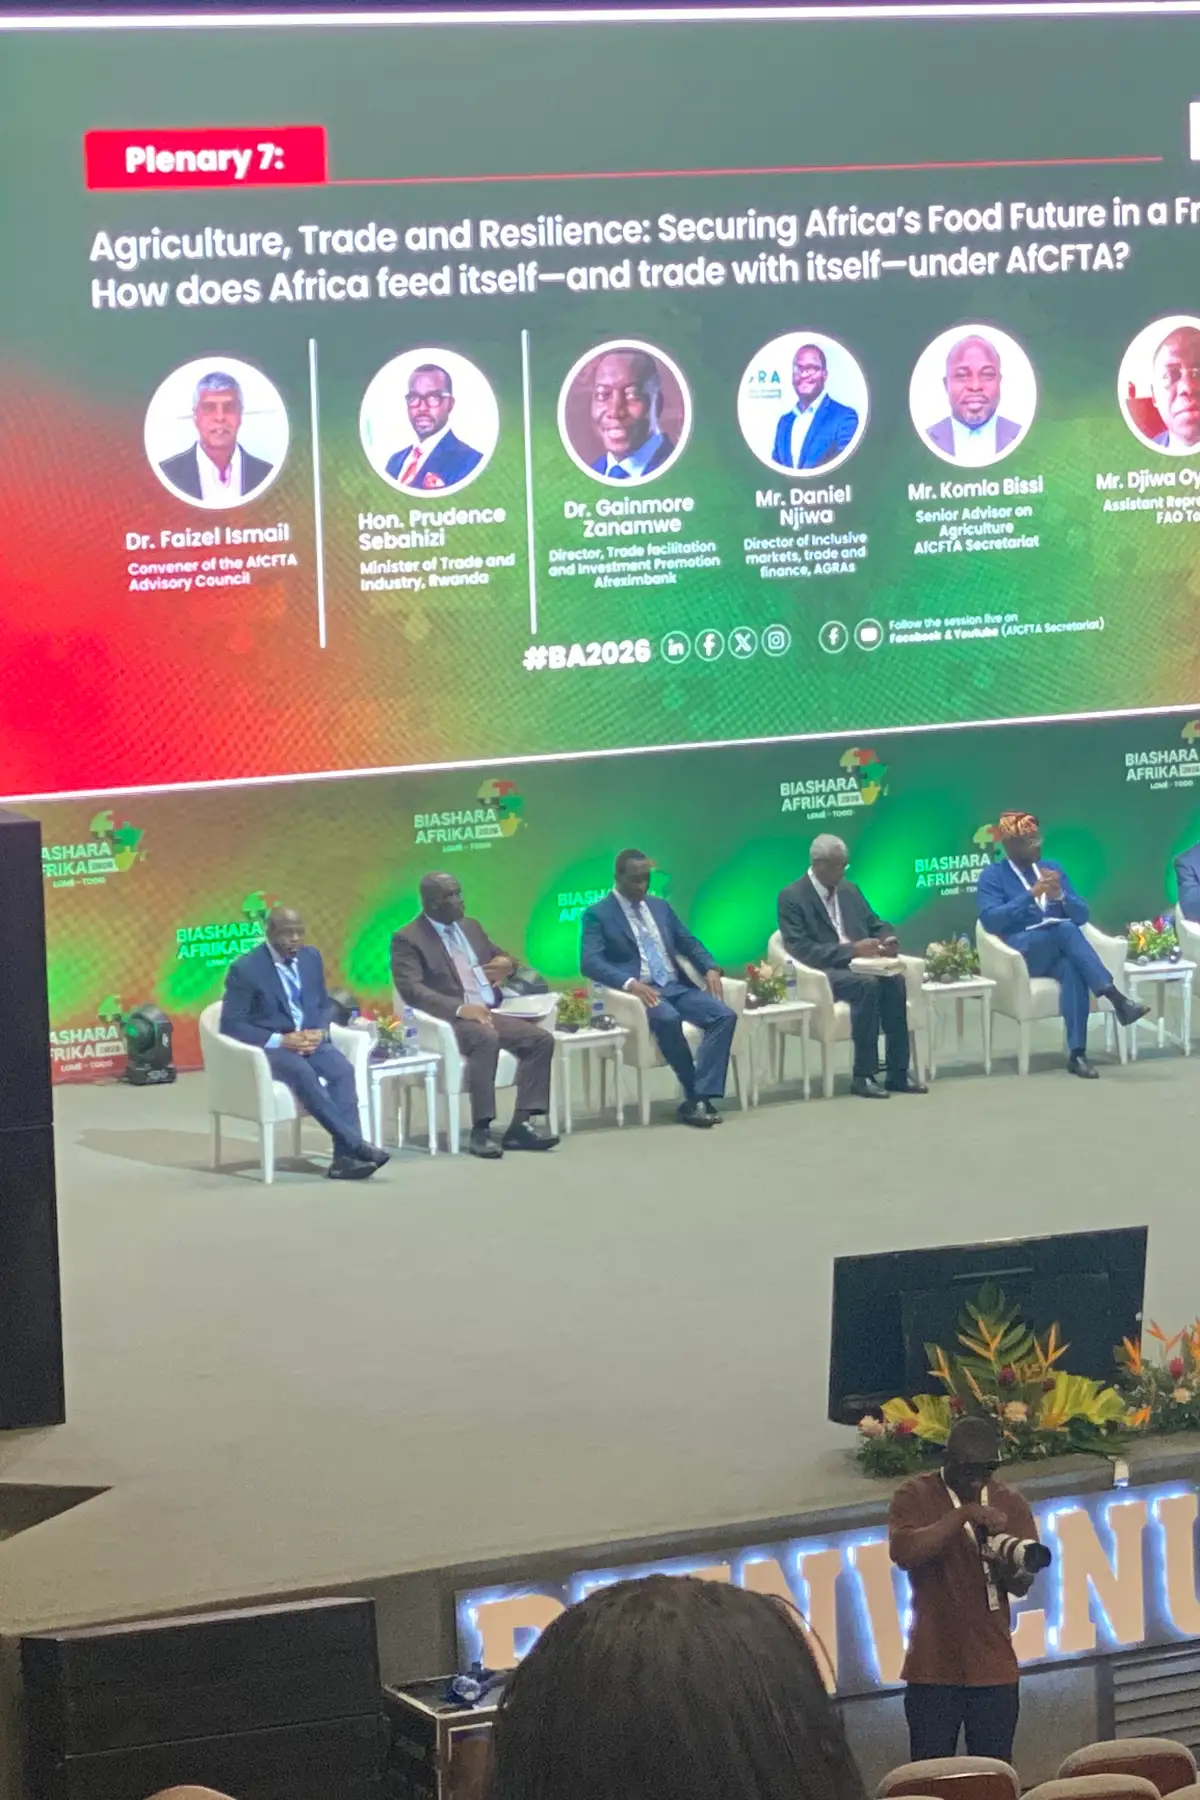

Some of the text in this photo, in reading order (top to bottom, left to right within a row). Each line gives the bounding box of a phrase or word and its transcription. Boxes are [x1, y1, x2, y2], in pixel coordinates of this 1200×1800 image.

[125, 144, 285, 180] Plenary 7:
[90, 225, 292, 268] Agriculture,
[300, 222, 398, 255] Trade
[405, 221, 472, 251] and
[480, 215, 651, 249] Resilience:
[658, 210, 798, 249] Securing
[929, 202, 1002, 234] Food
[1009, 199, 1107, 232] Future
[1112, 197, 1139, 226] in
[1147, 202, 1167, 226] a
[91, 277, 168, 309] How
[176, 274, 260, 306] does
[269, 268, 369, 303] Africa
[376, 266, 452, 298] feed
[638, 257, 725, 287] trade
[732, 253, 798, 283] with
[1007, 241, 1130, 273] AfCFTA?
[908, 475, 1043, 501] Mr. Komla Bissi
[1096, 474, 1123, 490] Mr.
[1127, 468, 1176, 493] Djiwa
[755, 485, 852, 507] Mr. Daniel
[1103, 498, 1164, 512] Assistant
[564, 496, 694, 518] Dr. Gainmore
[916, 506, 1033, 523] Senior Advisor on
[359, 506, 506, 530] Hon. Prudence
[583, 517, 682, 538] Zanamwe
[780, 507, 833, 530] Njiwa
[1156, 512, 1184, 525] FAO
[126, 523, 290, 550] Dr. Faizel Ismail
[359, 528, 445, 551] Sebahizi
[939, 522, 1014, 538] Agriculture
[744, 532, 867, 550] Director of Inclusive
[914, 535, 1039, 555] AfCFTA Secretariat
[549, 548, 604, 562] Director,
[607, 545, 645, 558] Trade
[745, 546, 866, 565] markets, trade and
[128, 553, 298, 576] Convener of the AfCFTA
[360, 553, 515, 576] Minister of Trade and
[548, 555, 721, 577] and Investment Promotion
[760, 565, 811, 579] finance,
[129, 572, 250, 593] Advisory Council
[360, 572, 490, 592] Industry, Rwanda
[594, 574, 677, 589] Afreximbank
[889, 619, 922, 630] Follow
[924, 618, 941, 629] the
[984, 613, 1003, 624] live
[1002, 623, 1043, 638] (AfCFTA
[1045, 616, 1105, 634] Secretariat)
[523, 638, 651, 670] #BA2026
[1125, 748, 1198, 767] BIASHARA
[1126, 765, 1180, 782] AFRIKA
[780, 777, 858, 796] BIASHARA
[781, 794, 839, 812] AFRIKA
[414, 808, 496, 828] BIASHARA
[415, 827, 475, 844] AFRIKA
[41, 842, 111, 861] ASHARA
[914, 853, 991, 873] BIASHARA
[916, 870, 972, 888] AFRIKA
[176, 921, 263, 942] BIASHARA
[177, 940, 240, 959] AFRIKA
[50, 1025, 118, 1045] ASHARA
